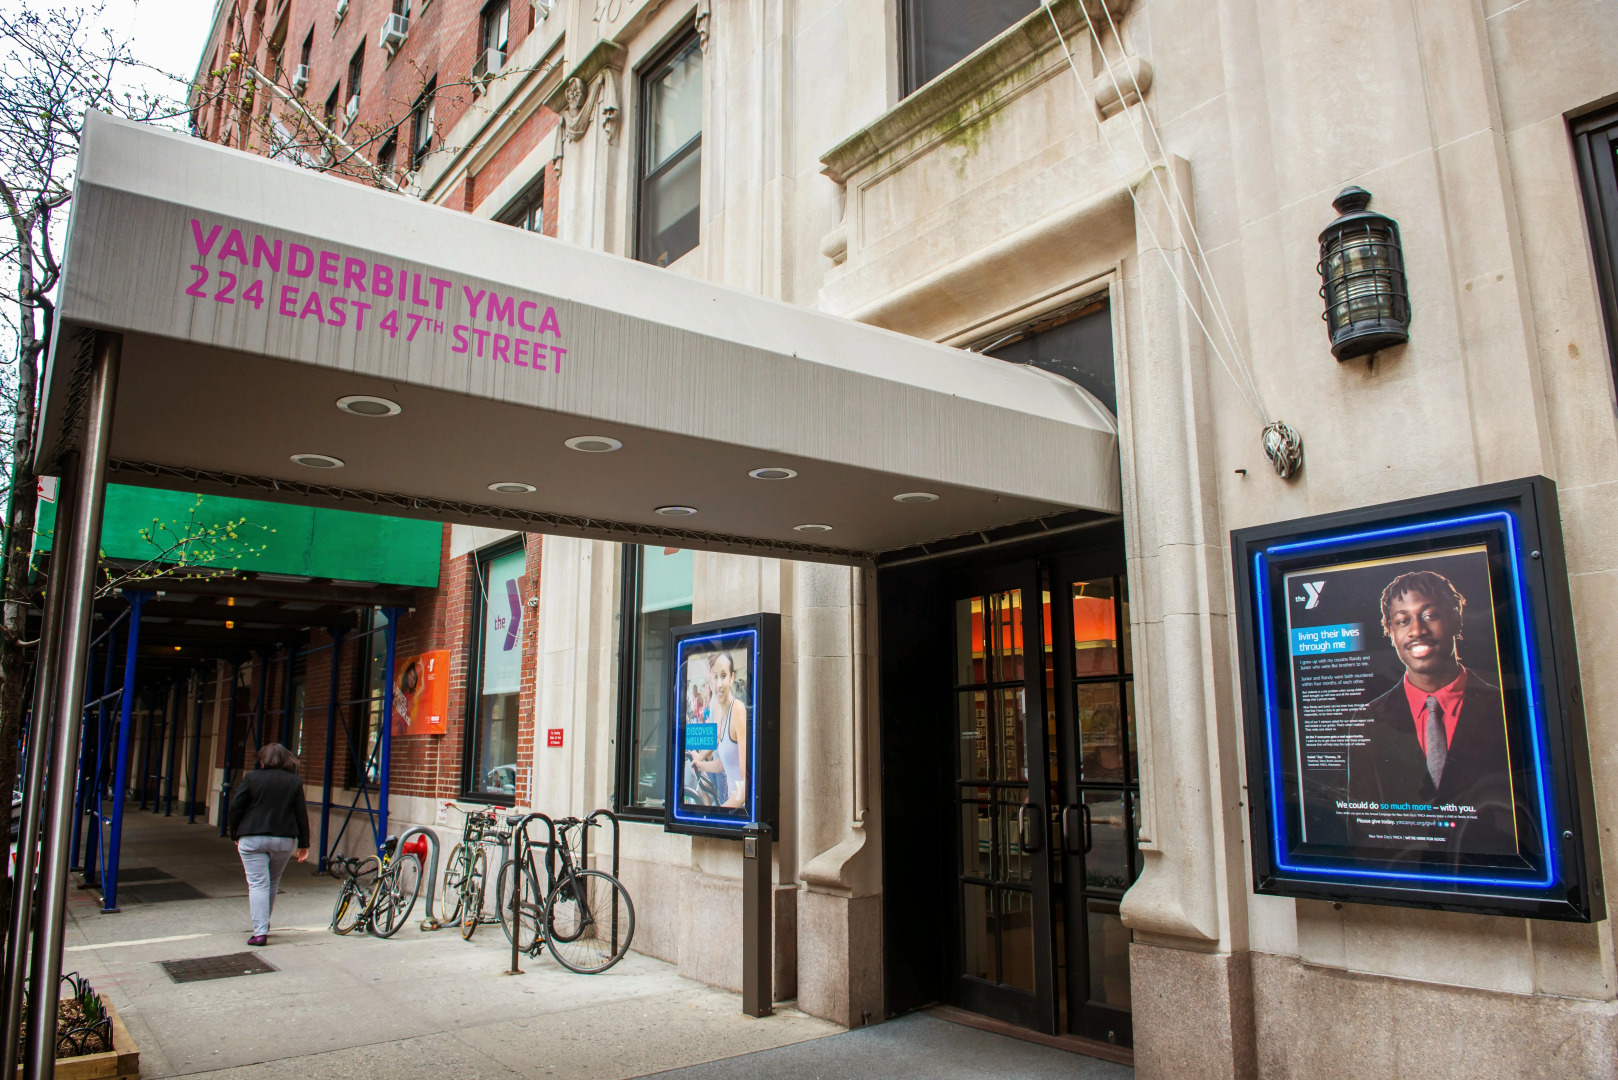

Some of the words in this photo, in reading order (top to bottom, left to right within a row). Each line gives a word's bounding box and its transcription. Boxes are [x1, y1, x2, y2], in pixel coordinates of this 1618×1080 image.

[191, 219, 452, 310] VANDERBILT
[464, 286, 560, 338] YMCA
[186, 265, 264, 309] 224
[279, 285, 371, 331] EAST
[379, 310, 443, 341] 47TH
[452, 325, 567, 373] STREET
[1302, 581, 1325, 609] Y
[494, 615, 506, 630] the
[1299, 632, 1319, 641] living
[1321, 630, 1339, 639] their
[1341, 628, 1360, 637] lives
[1299, 641, 1331, 652] through
[686, 726, 714, 736] DISCOVER
[686, 736, 714, 746] WELLNESS
[1336, 800, 1348, 809] We
[1349, 801, 1369, 809] could
[1370, 801, 1379, 810] do
[1390, 802, 1411, 811] much
[1440, 803, 1458, 812] with
[1459, 805, 1477, 814] you.
